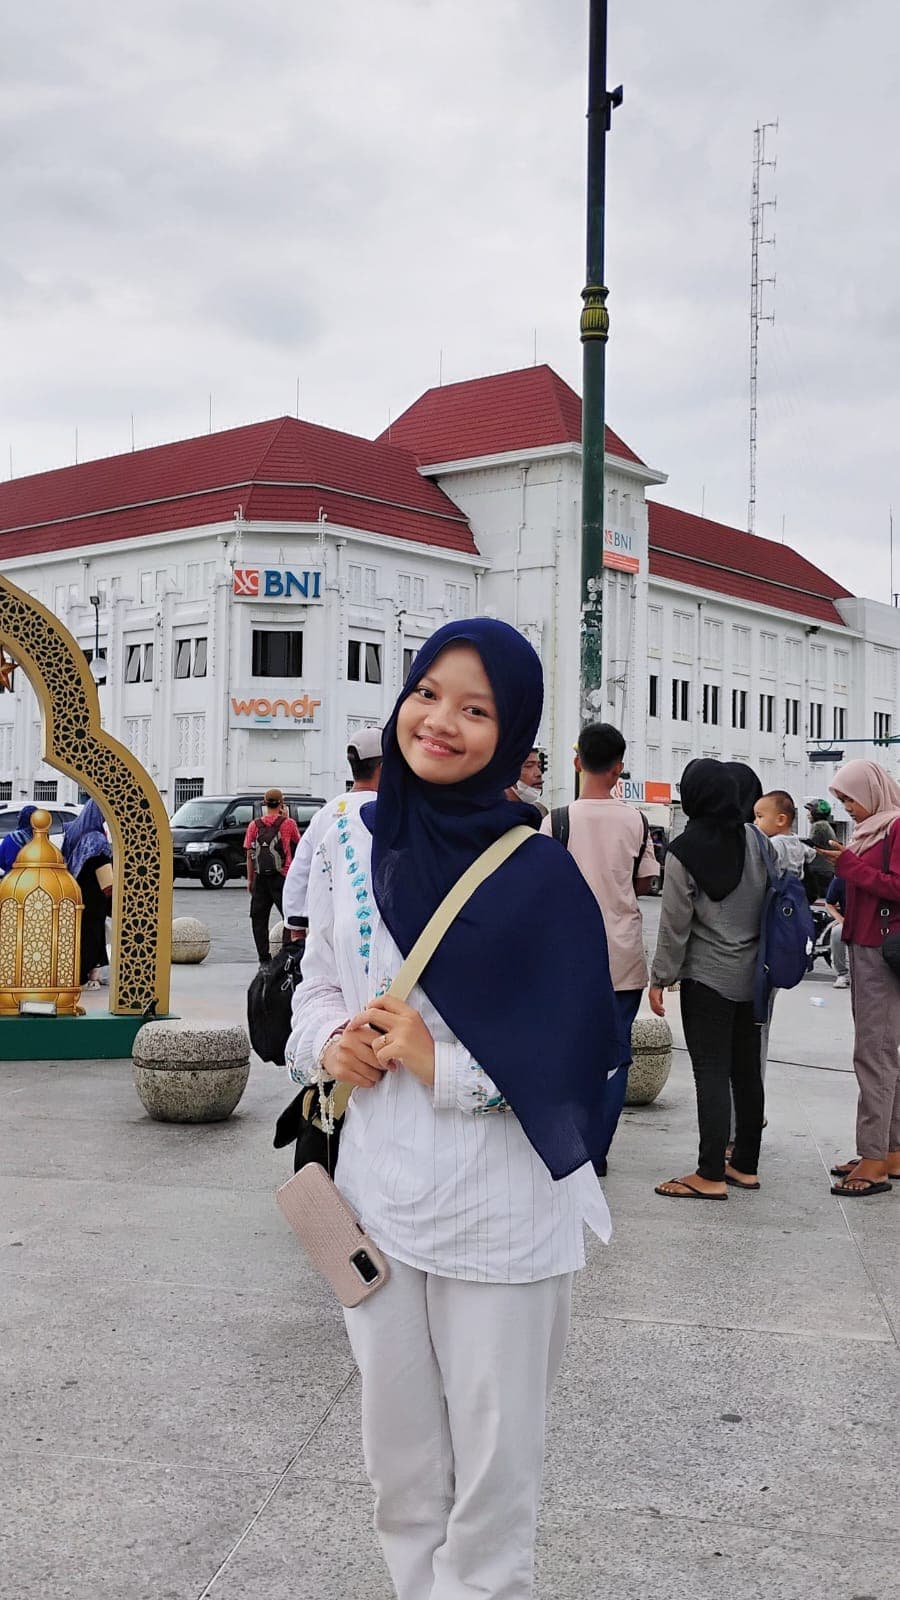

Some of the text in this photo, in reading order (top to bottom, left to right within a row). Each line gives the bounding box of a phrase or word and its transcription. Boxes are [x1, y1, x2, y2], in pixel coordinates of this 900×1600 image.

[614, 531, 632, 550] BNI
[264, 570, 321, 598] BNI
[231, 694, 321, 717] wondr
[624, 782, 644, 800] BNI
